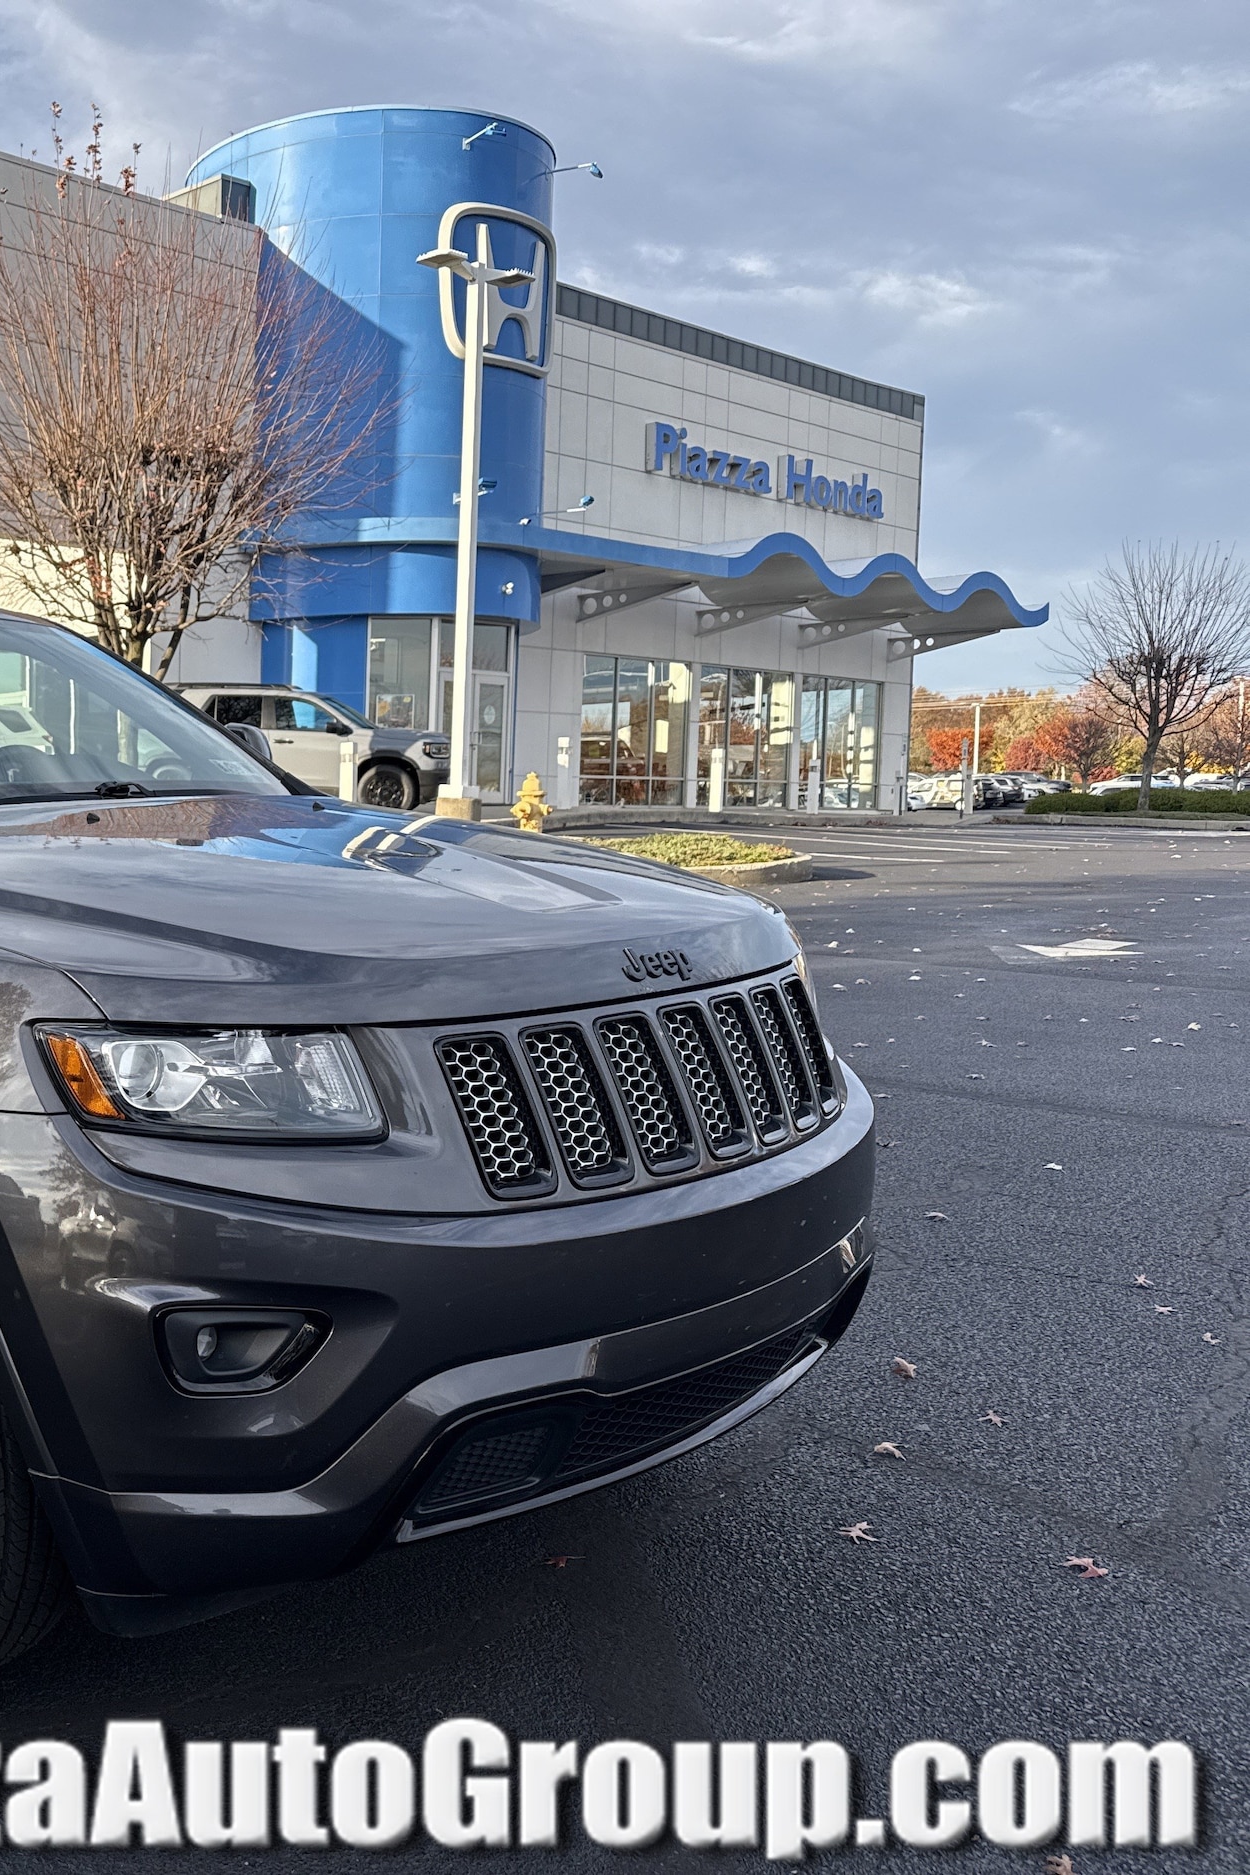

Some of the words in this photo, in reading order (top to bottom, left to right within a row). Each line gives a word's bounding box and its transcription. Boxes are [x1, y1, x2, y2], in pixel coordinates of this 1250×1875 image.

[645, 422, 772, 494] Piazza
[778, 454, 884, 519] Honda
[622, 947, 693, 982] Jeep
